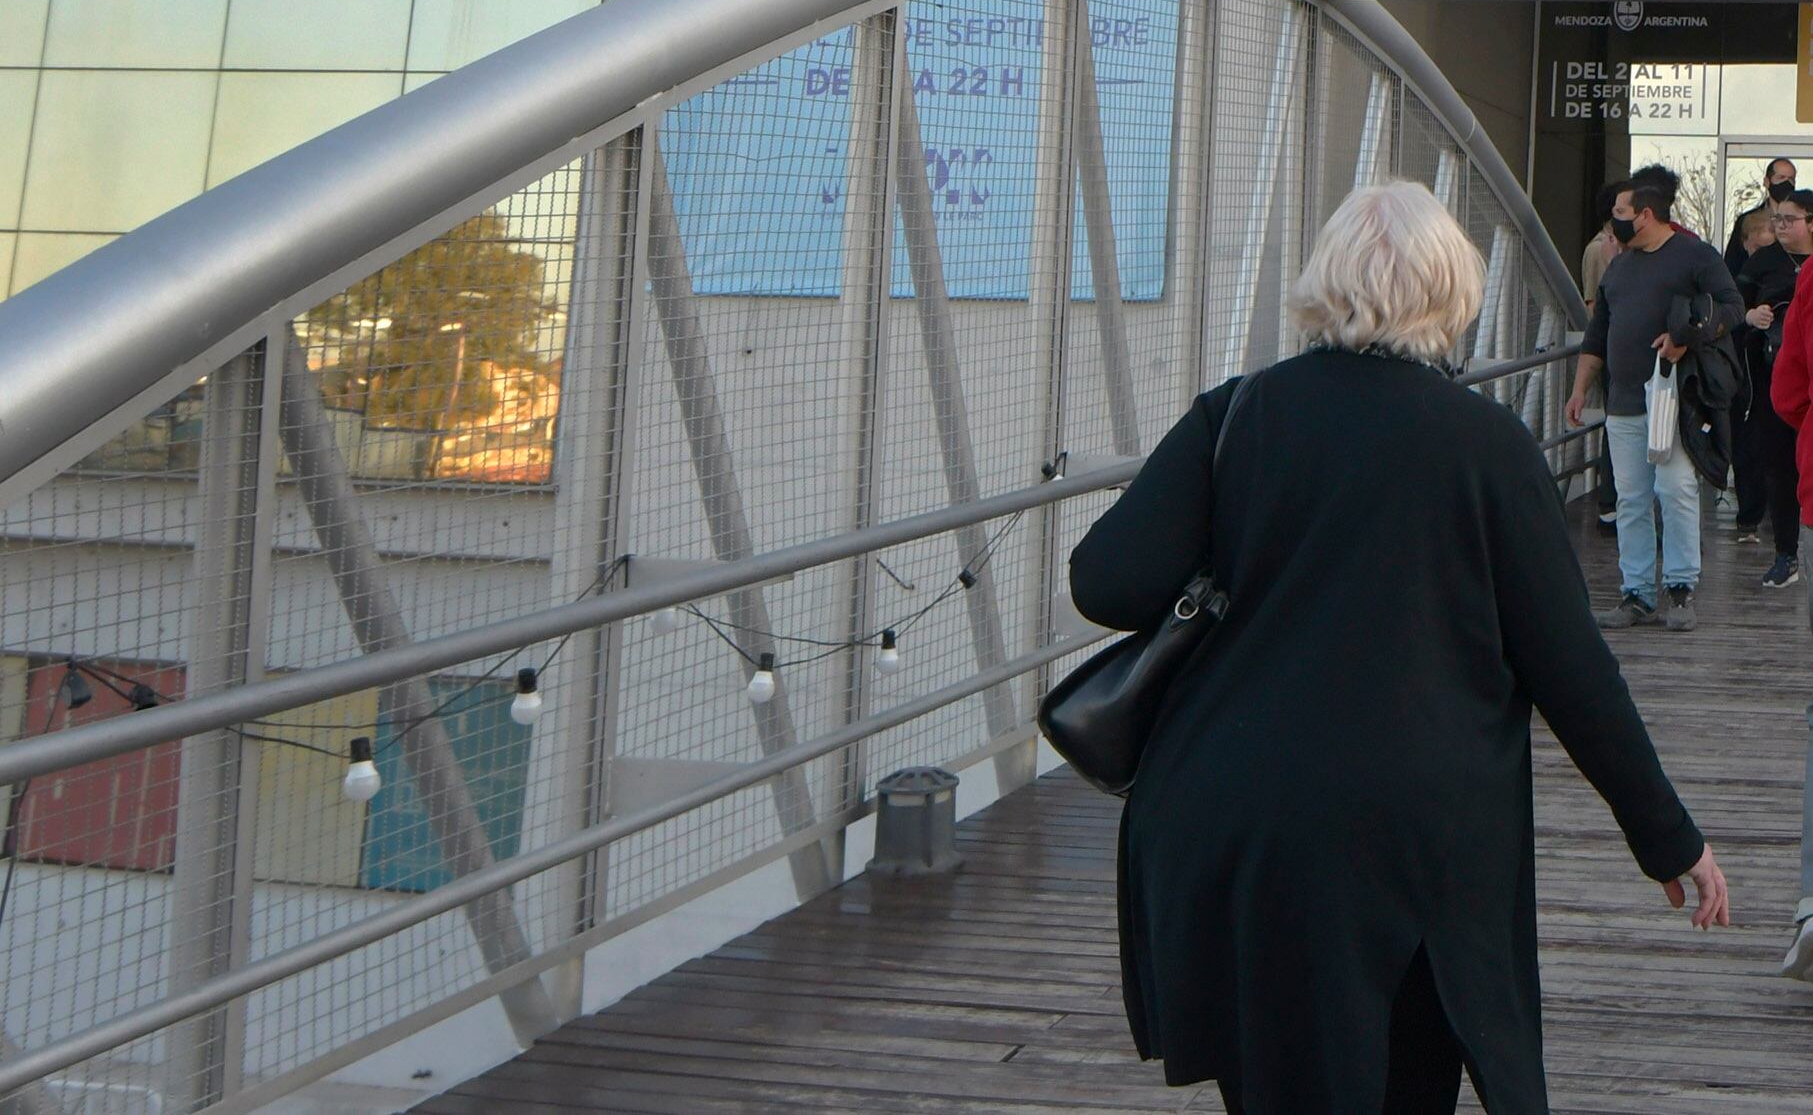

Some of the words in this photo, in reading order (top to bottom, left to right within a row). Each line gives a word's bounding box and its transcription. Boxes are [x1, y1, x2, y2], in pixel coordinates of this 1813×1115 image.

[1554, 15, 1613, 26] MENDOZA
[1643, 16, 1708, 26] ARGENTINA
[1566, 61, 1608, 80] DEL
[1615, 62, 1627, 80] 2
[1635, 62, 1662, 80] AL
[1671, 62, 1693, 80] 11
[913, 68, 937, 96] A
[947, 66, 989, 96] 22
[1002, 67, 1024, 96] H
[1565, 84, 1588, 98] DE
[1592, 84, 1692, 98] SEPTIEMBRE
[1565, 101, 1592, 118] DE
[1600, 101, 1622, 118] 16
[1628, 102, 1642, 118] A
[1649, 103, 1672, 118] 22
[1679, 103, 1693, 119] H
